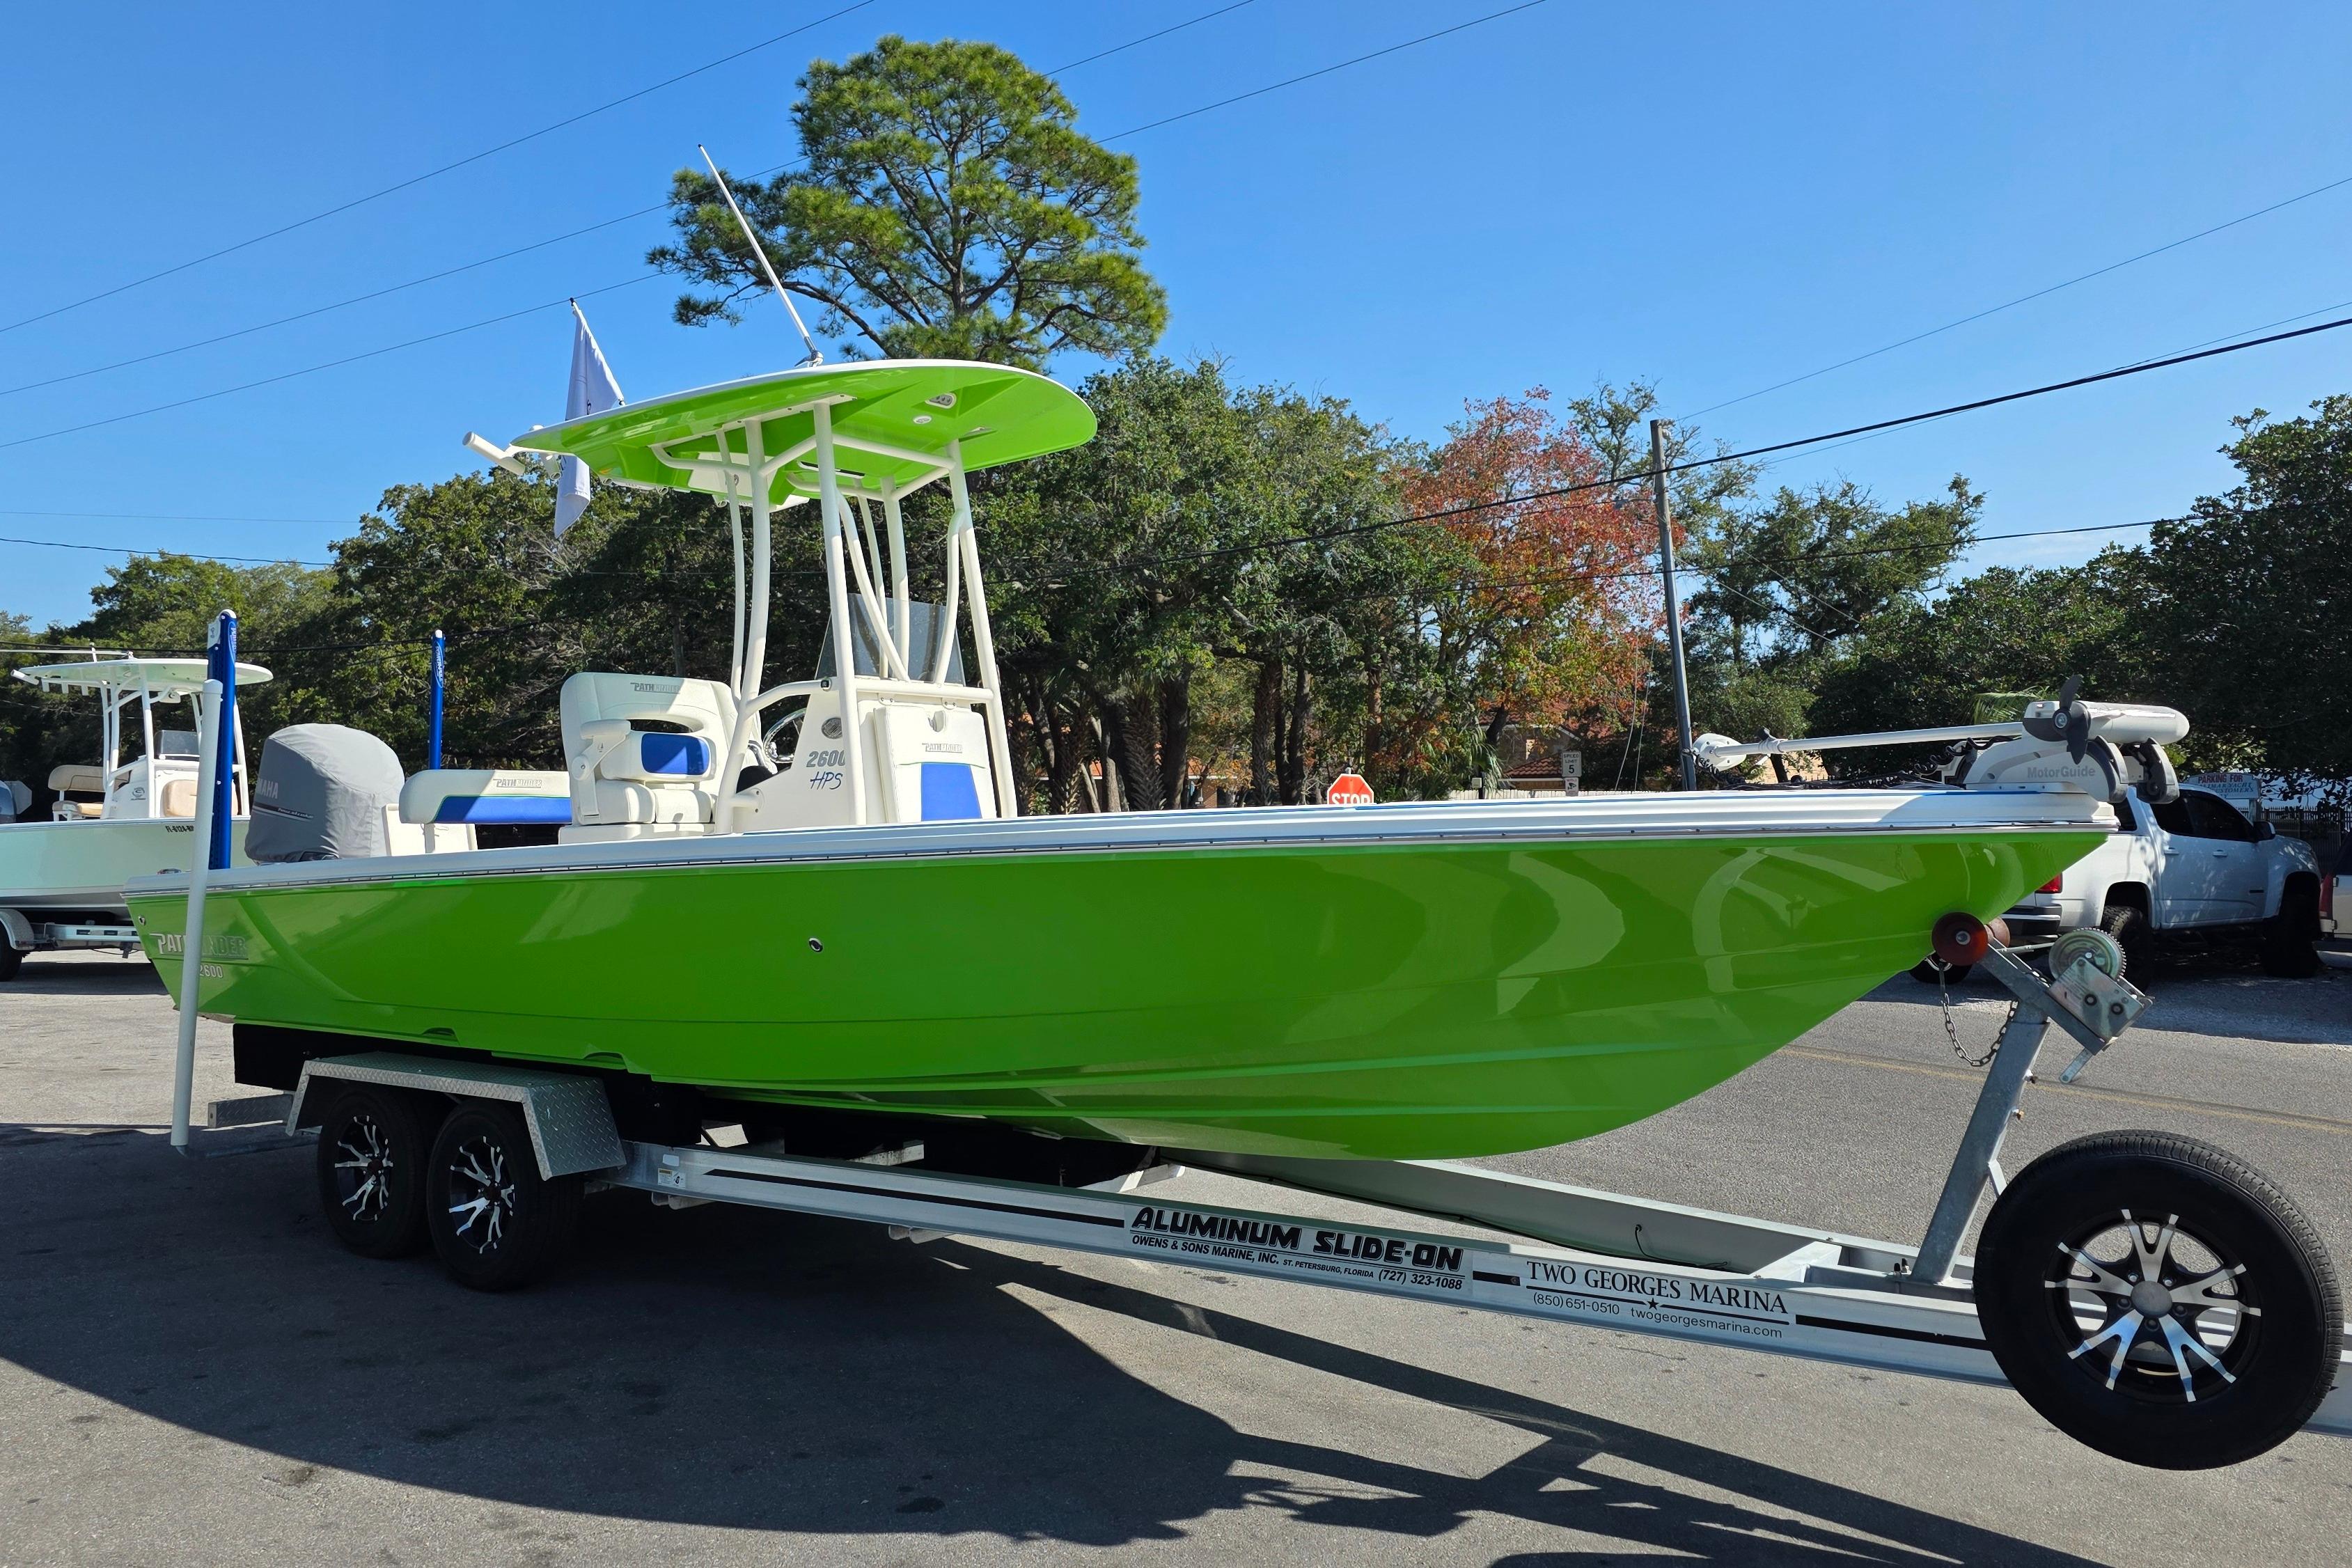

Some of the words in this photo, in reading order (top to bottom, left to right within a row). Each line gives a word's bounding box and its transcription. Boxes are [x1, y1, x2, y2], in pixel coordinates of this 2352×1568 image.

[810, 771, 843, 790] HPS
[1569, 765, 1574, 774] 5
[2028, 766, 2095, 778] MotorGuide
[2197, 774, 2227, 783] PARKING
[2230, 774, 2243, 783] FOR
[1131, 1207, 1302, 1250] ALUMINUM
[1313, 1230, 1464, 1271] SLIDE-ON
[1132, 1234, 1168, 1248] OWENS
[1171, 1240, 1178, 1250] &
[1181, 1241, 1209, 1255] SONS
[1212, 1246, 1255, 1263] MARINE,
[1257, 1252, 1279, 1264] INC.
[1283, 1259, 1294, 1267] ST.
[1295, 1261, 1342, 1275] PETERSBURG,
[1344, 1267, 1374, 1278] FLORIDA
[1379, 1269, 1406, 1285] (727)
[1411, 1273, 1463, 1290] 323-1088
[1527, 1261, 1576, 1285] TWO
[1585, 1269, 1681, 1299] GEORGES
[1690, 1283, 1789, 1314] MARINA
[1631, 1307, 1782, 1338] twogeorgesmarina.com
